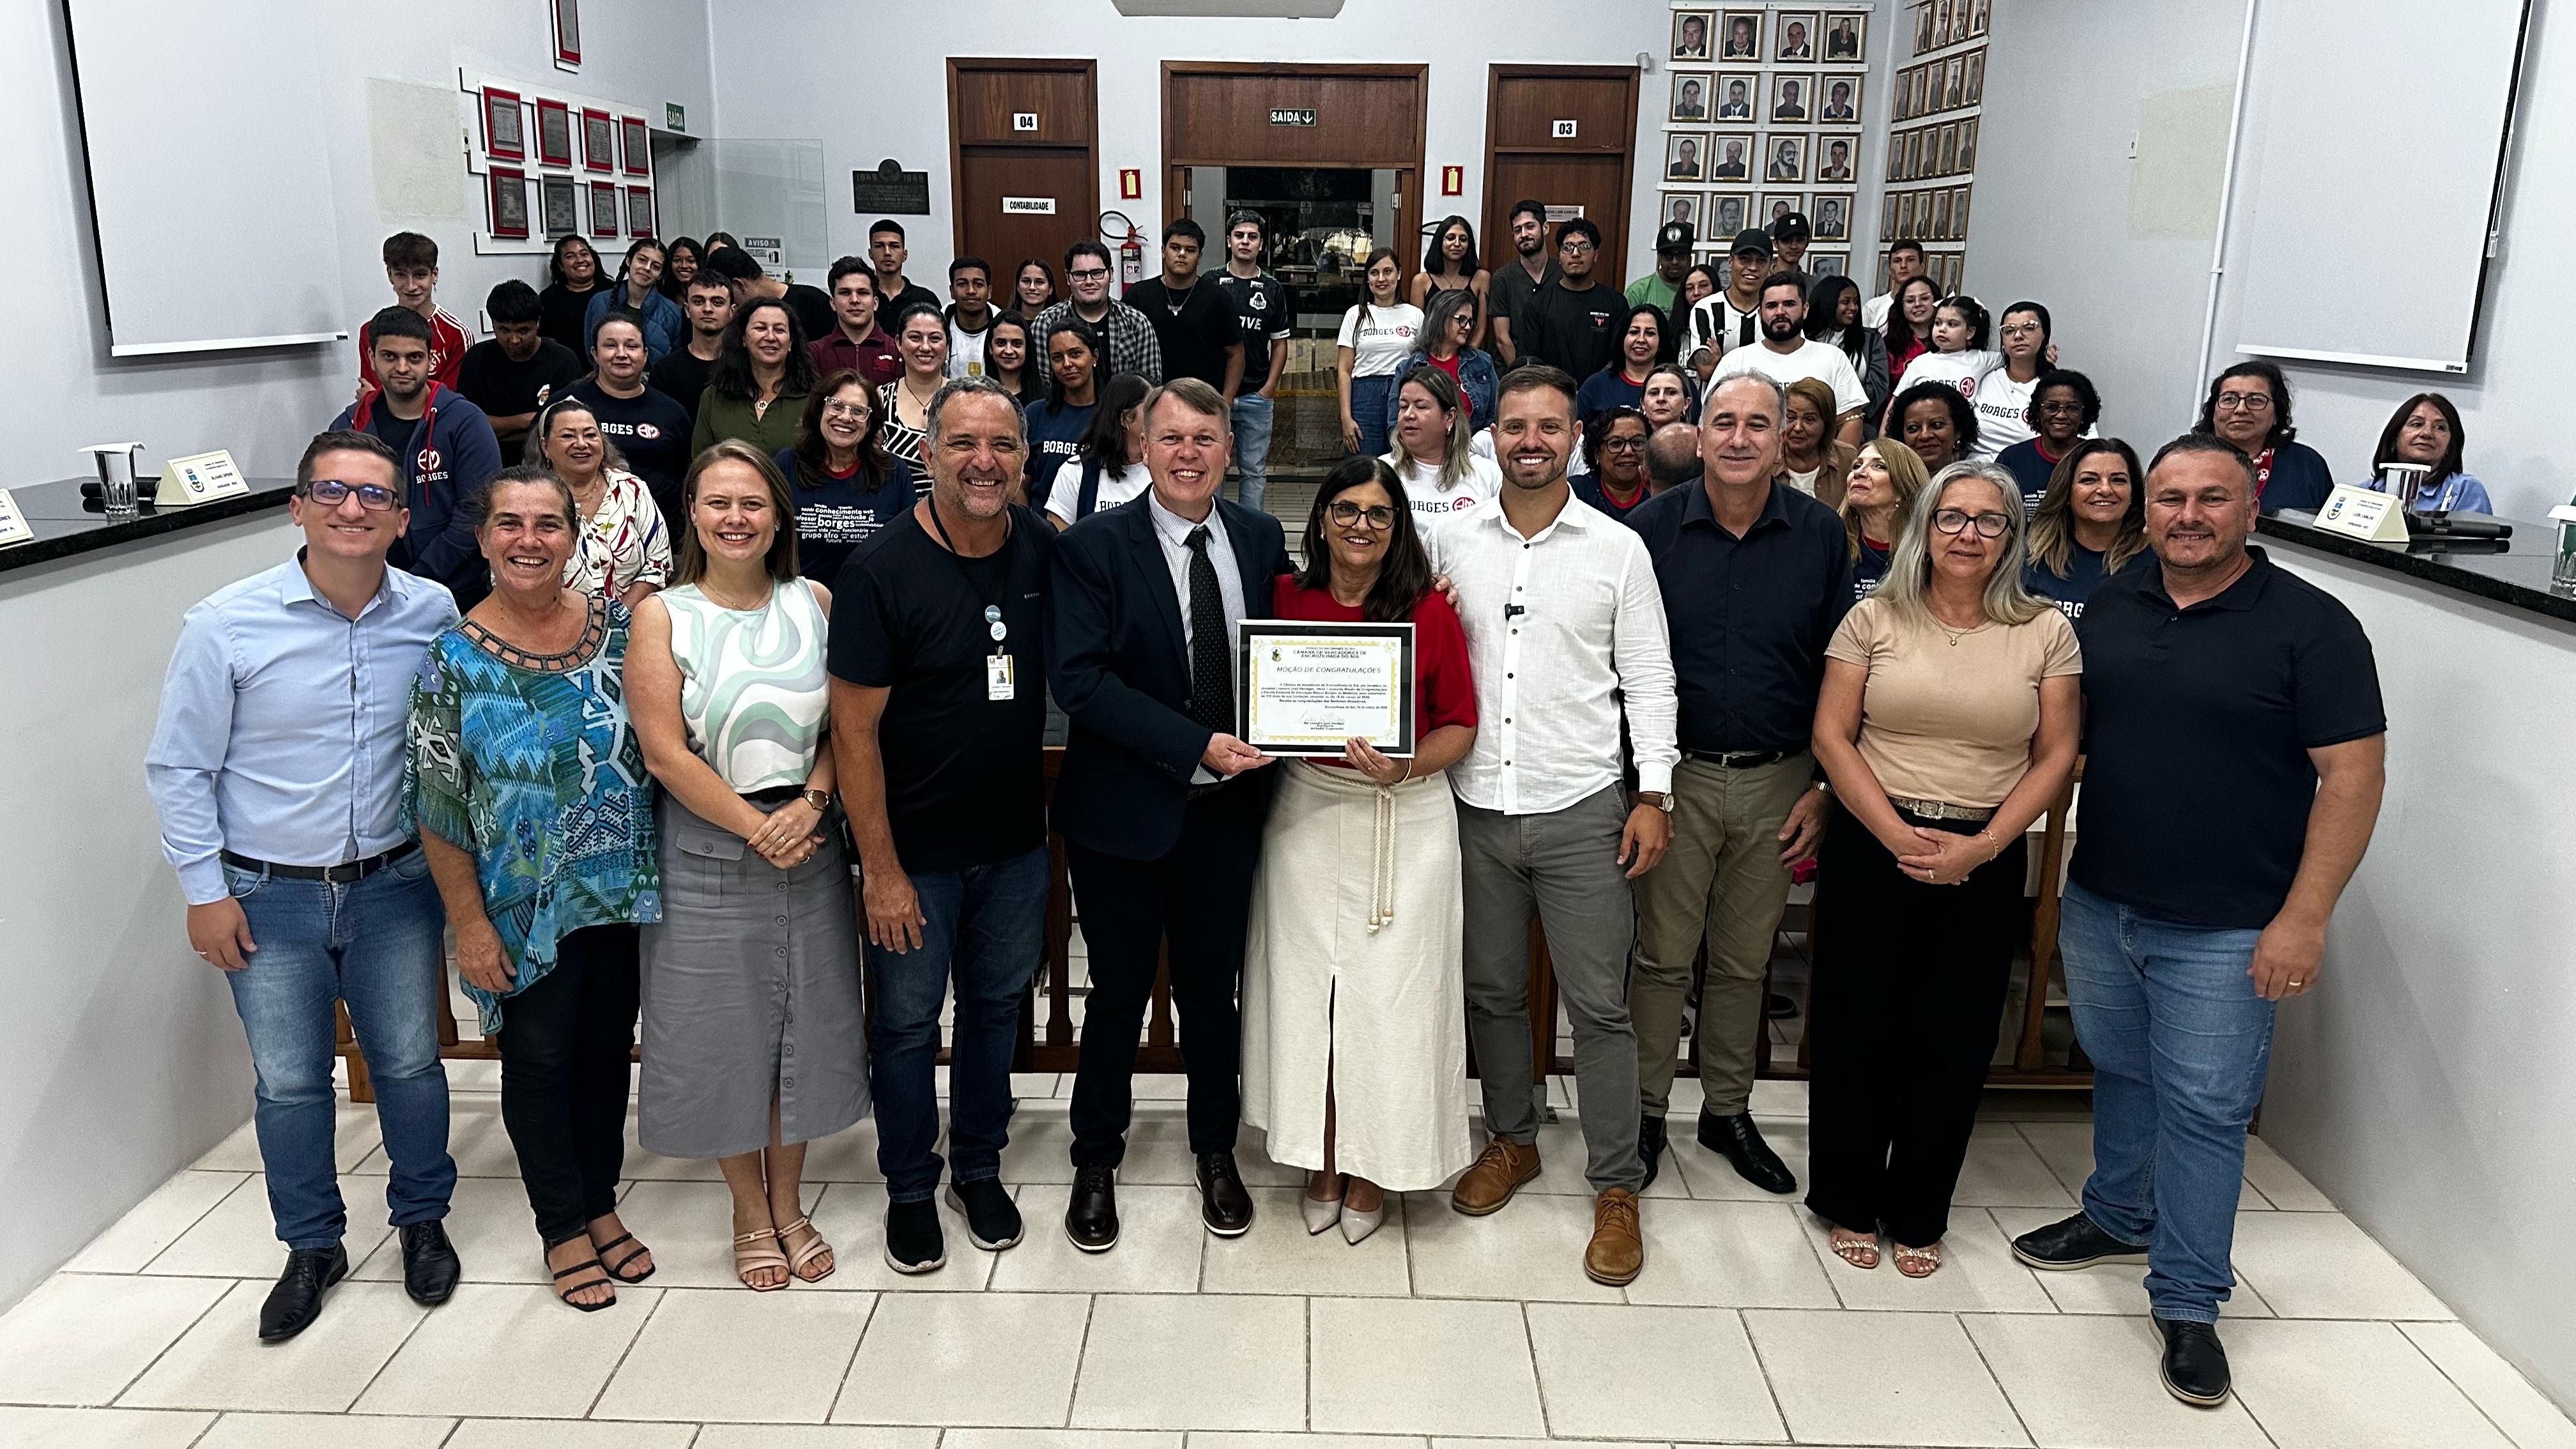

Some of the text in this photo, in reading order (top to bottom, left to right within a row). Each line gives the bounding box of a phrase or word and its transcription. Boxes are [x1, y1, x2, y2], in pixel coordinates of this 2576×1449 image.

[1020, 116, 1034, 128] 04
[1271, 110, 1300, 122] SAÍDA
[1559, 123, 1573, 135] 03
[1009, 201, 1049, 211] CONTABILIDADE
[1981, 403, 2020, 419] BORGES
[601, 422, 633, 435] RGES
[1043, 441, 1085, 455] BORGE
[1409, 500, 1449, 513] ORGES
[818, 515, 855, 529] borges
